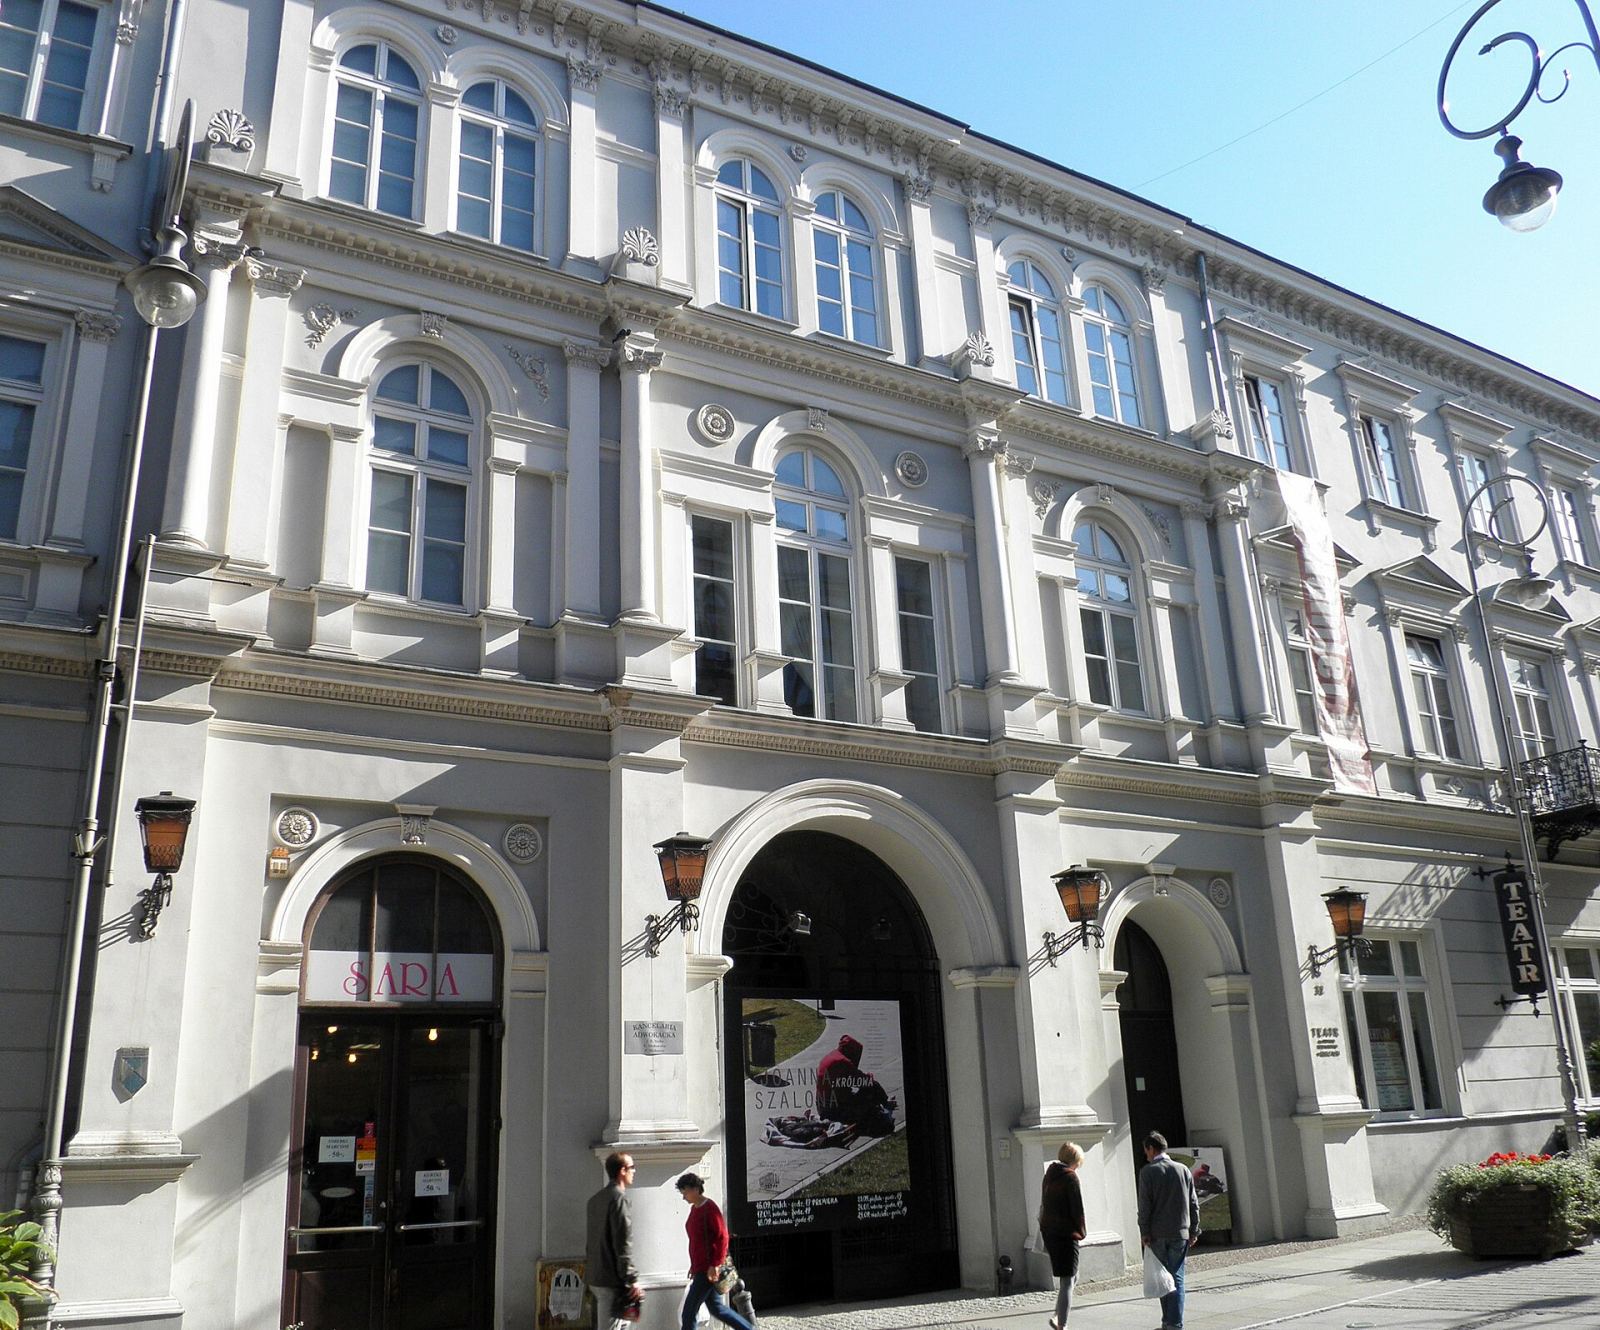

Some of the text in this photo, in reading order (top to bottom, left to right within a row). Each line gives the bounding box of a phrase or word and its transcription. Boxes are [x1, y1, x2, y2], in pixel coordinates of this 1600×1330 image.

[1503, 882, 1541, 983] TEATR
[342, 961, 461, 996] SARA
[760, 1068, 832, 1086] JOANNA
[755, 1090, 839, 1110] SZALONA
